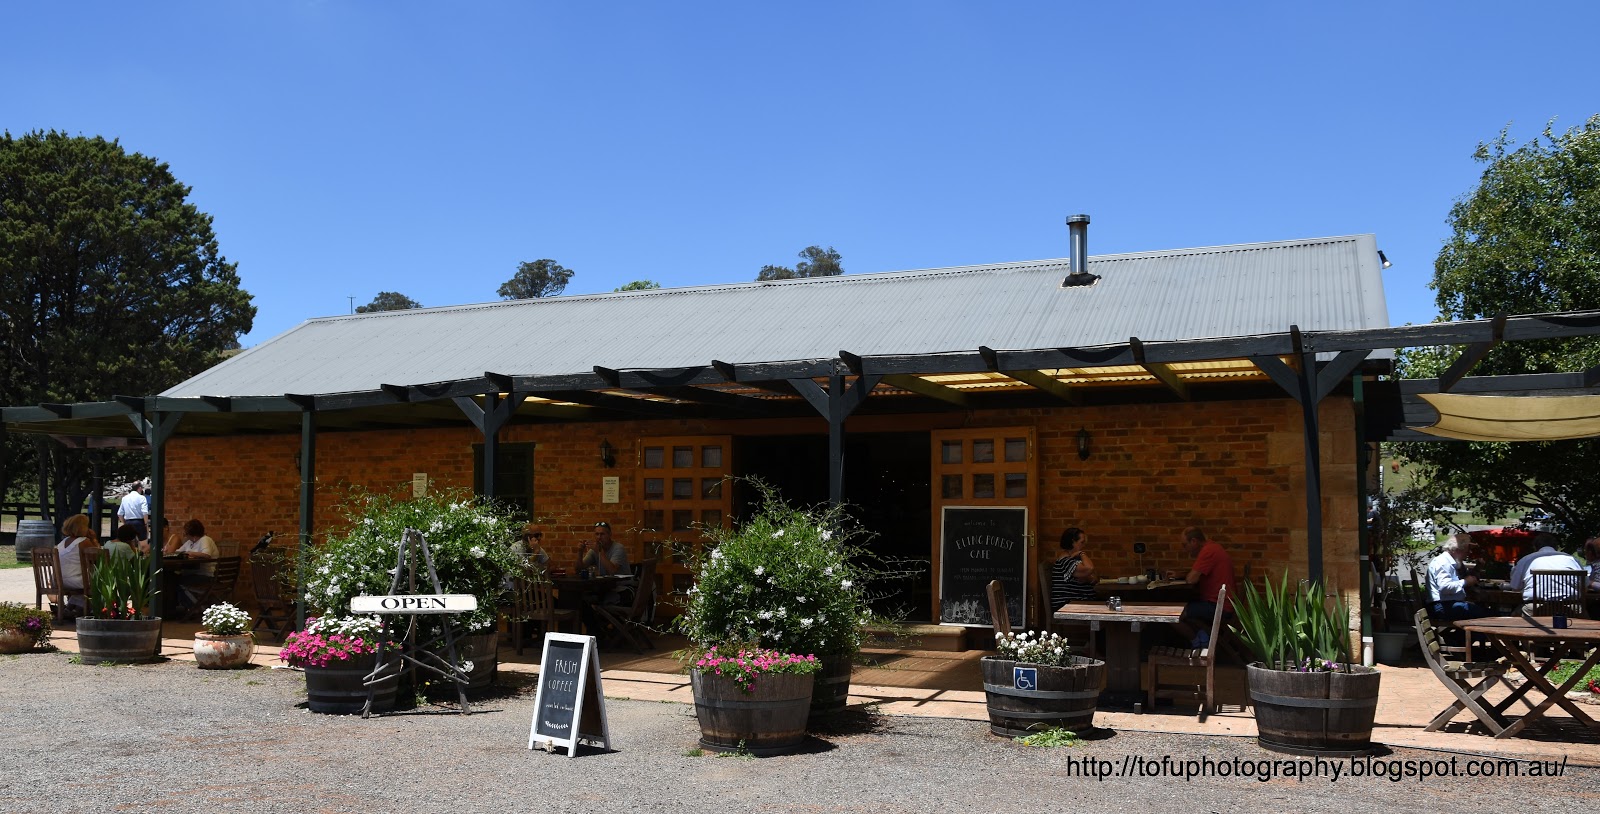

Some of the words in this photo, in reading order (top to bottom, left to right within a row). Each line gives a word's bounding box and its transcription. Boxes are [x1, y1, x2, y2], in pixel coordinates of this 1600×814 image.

[985, 535, 1014, 551] FOREST
[381, 598, 446, 609] OPEN
[555, 659, 577, 675] FRESH
[548, 680, 573, 692] COFFEE
